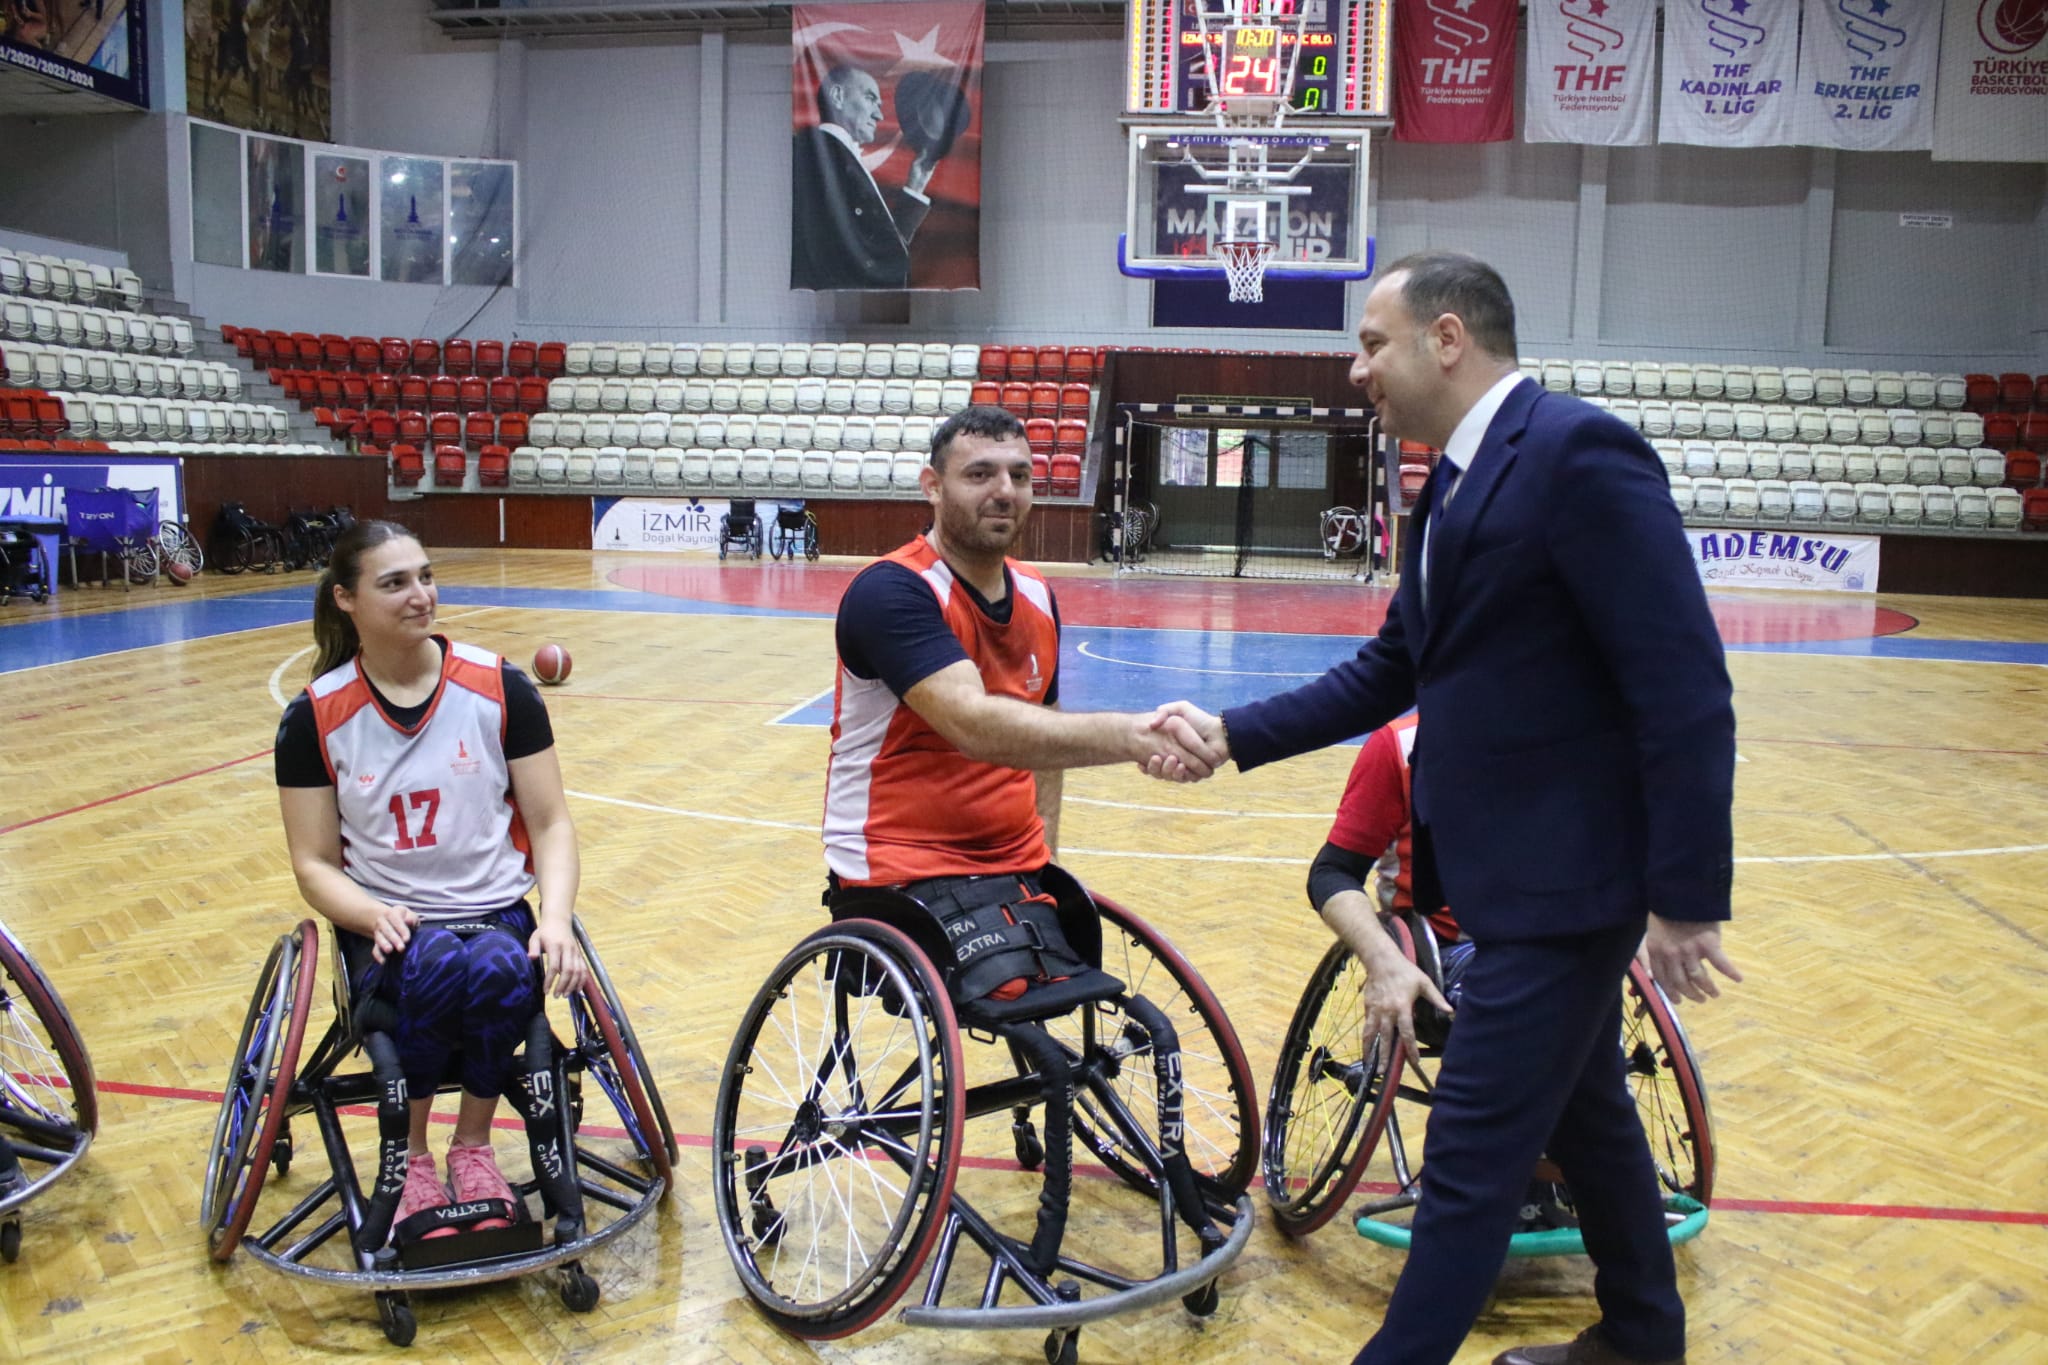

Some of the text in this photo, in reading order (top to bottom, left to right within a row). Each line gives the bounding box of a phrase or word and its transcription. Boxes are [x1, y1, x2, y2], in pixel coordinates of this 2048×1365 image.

[1313, 56, 1327, 76] 0
[1421, 58, 1492, 84] THF
[1713, 64, 1751, 77] THF
[1850, 66, 1890, 81] THF
[1973, 56, 2048, 74] TÜRKİYE
[1226, 55, 1276, 94] 24
[1553, 65, 1627, 91] THF
[1971, 75, 2048, 86] BASKETBOL
[1420, 87, 1491, 97] Türkiye Hentbol
[1680, 79, 1782, 96] KADINLAR
[1814, 81, 1921, 99] ERKEKLER
[1970, 86, 2048, 95] FEDERASYONU
[1426, 96, 1484, 105] Federasyonu
[1553, 94, 1627, 105] Türkiye Hentbol
[1560, 103, 1619, 112] Federasyonu
[1704, 95, 1755, 114] 1. LİG
[1835, 100, 1893, 120] 2. LİG
[1167, 208, 1333, 237] MARATON
[642, 508, 711, 533] İZMİR
[388, 787, 441, 851] 17
[956, 932, 1006, 962] EXTRA
[387, 1079, 397, 1103] THE
[1160, 1051, 1183, 1159] EXTRA
[435, 1202, 490, 1219] EXTRA
